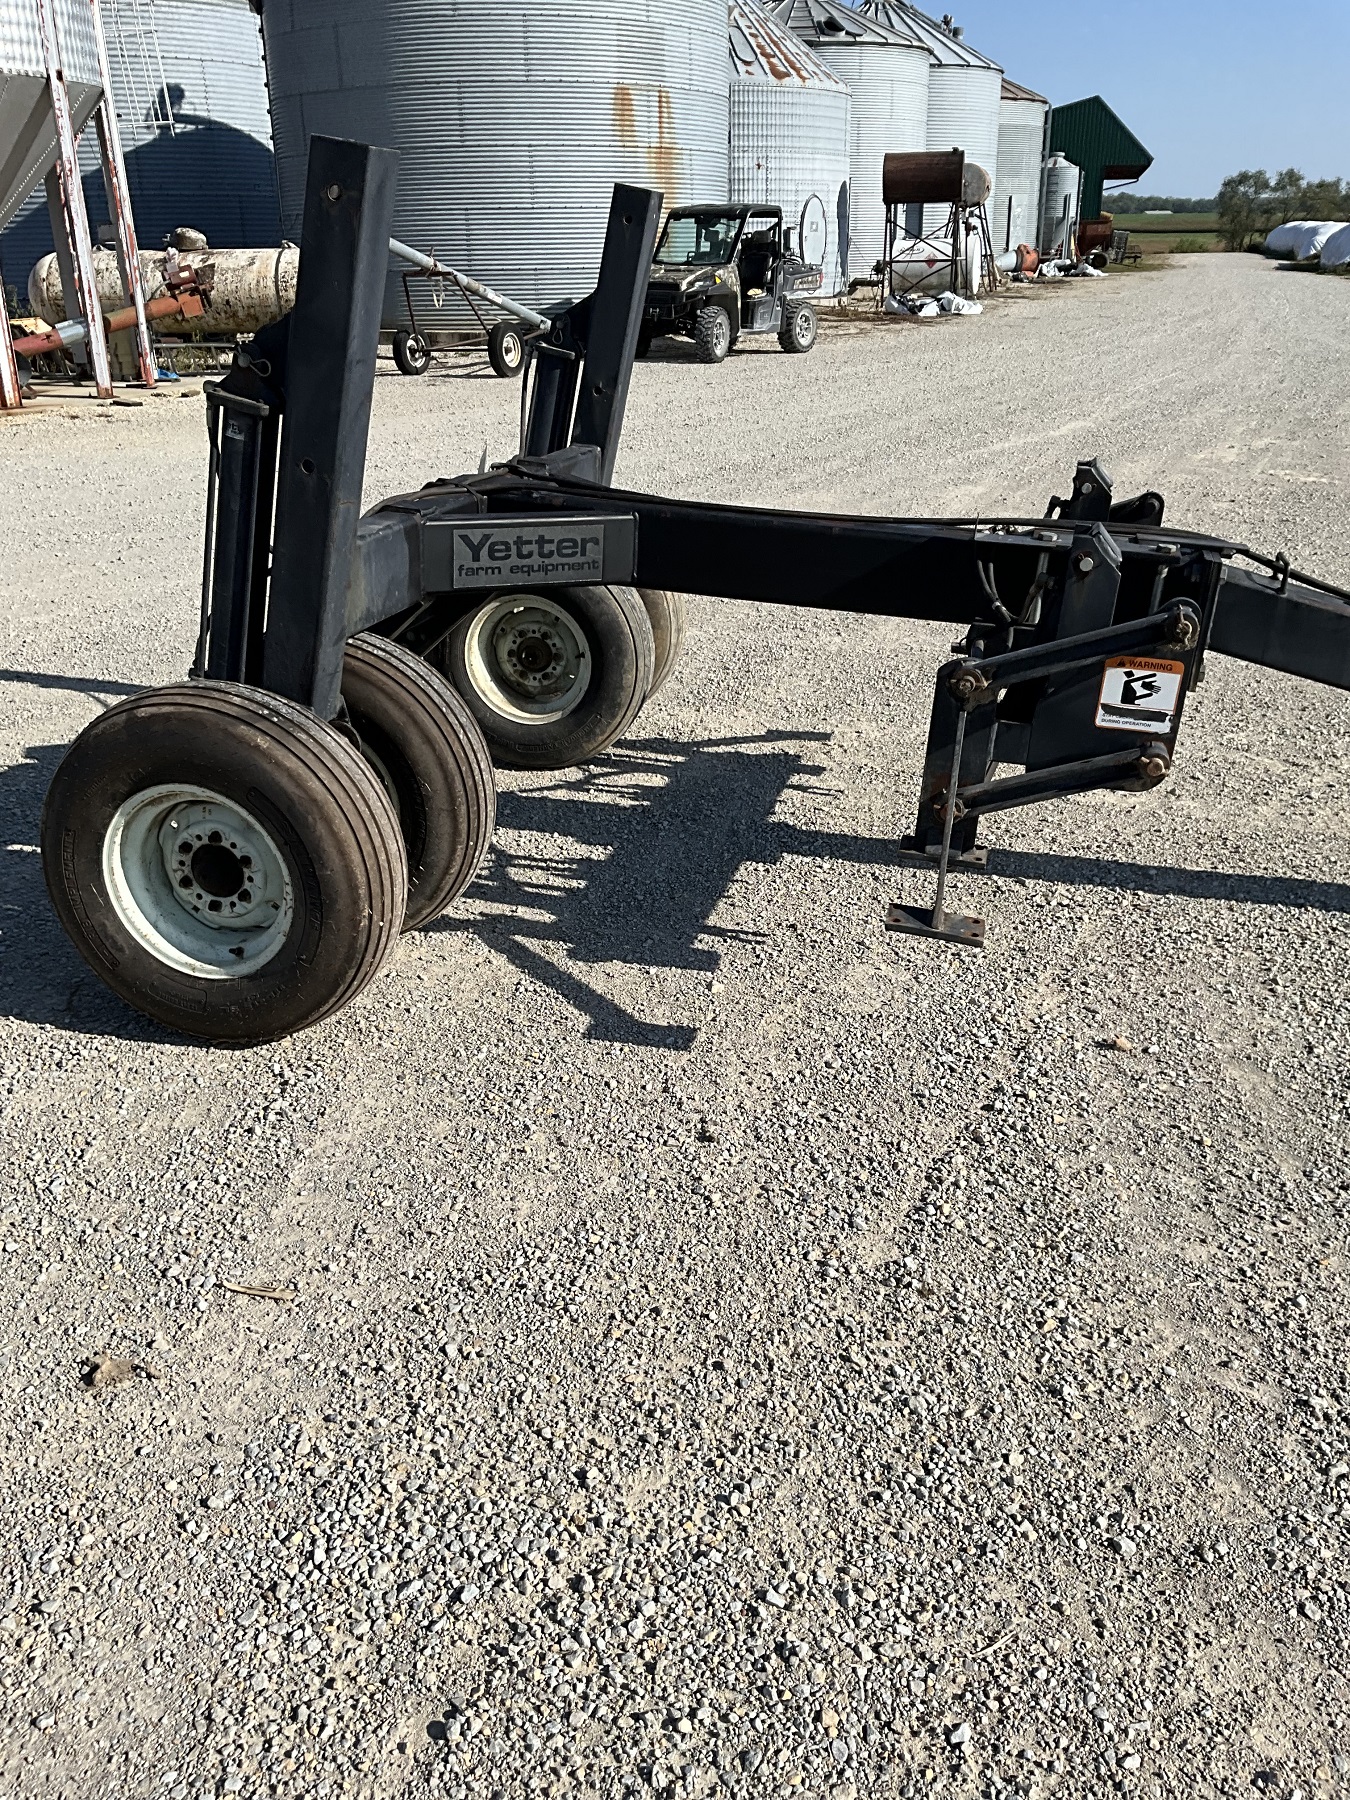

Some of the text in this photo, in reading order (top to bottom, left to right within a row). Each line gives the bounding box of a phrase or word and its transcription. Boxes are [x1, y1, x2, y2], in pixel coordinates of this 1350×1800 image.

[458, 533, 600, 562] Yetter
[457, 560, 599, 577] farm equipment
[1129, 660, 1173, 671] WARNING
[1122, 720, 1152, 728] OPERATION
